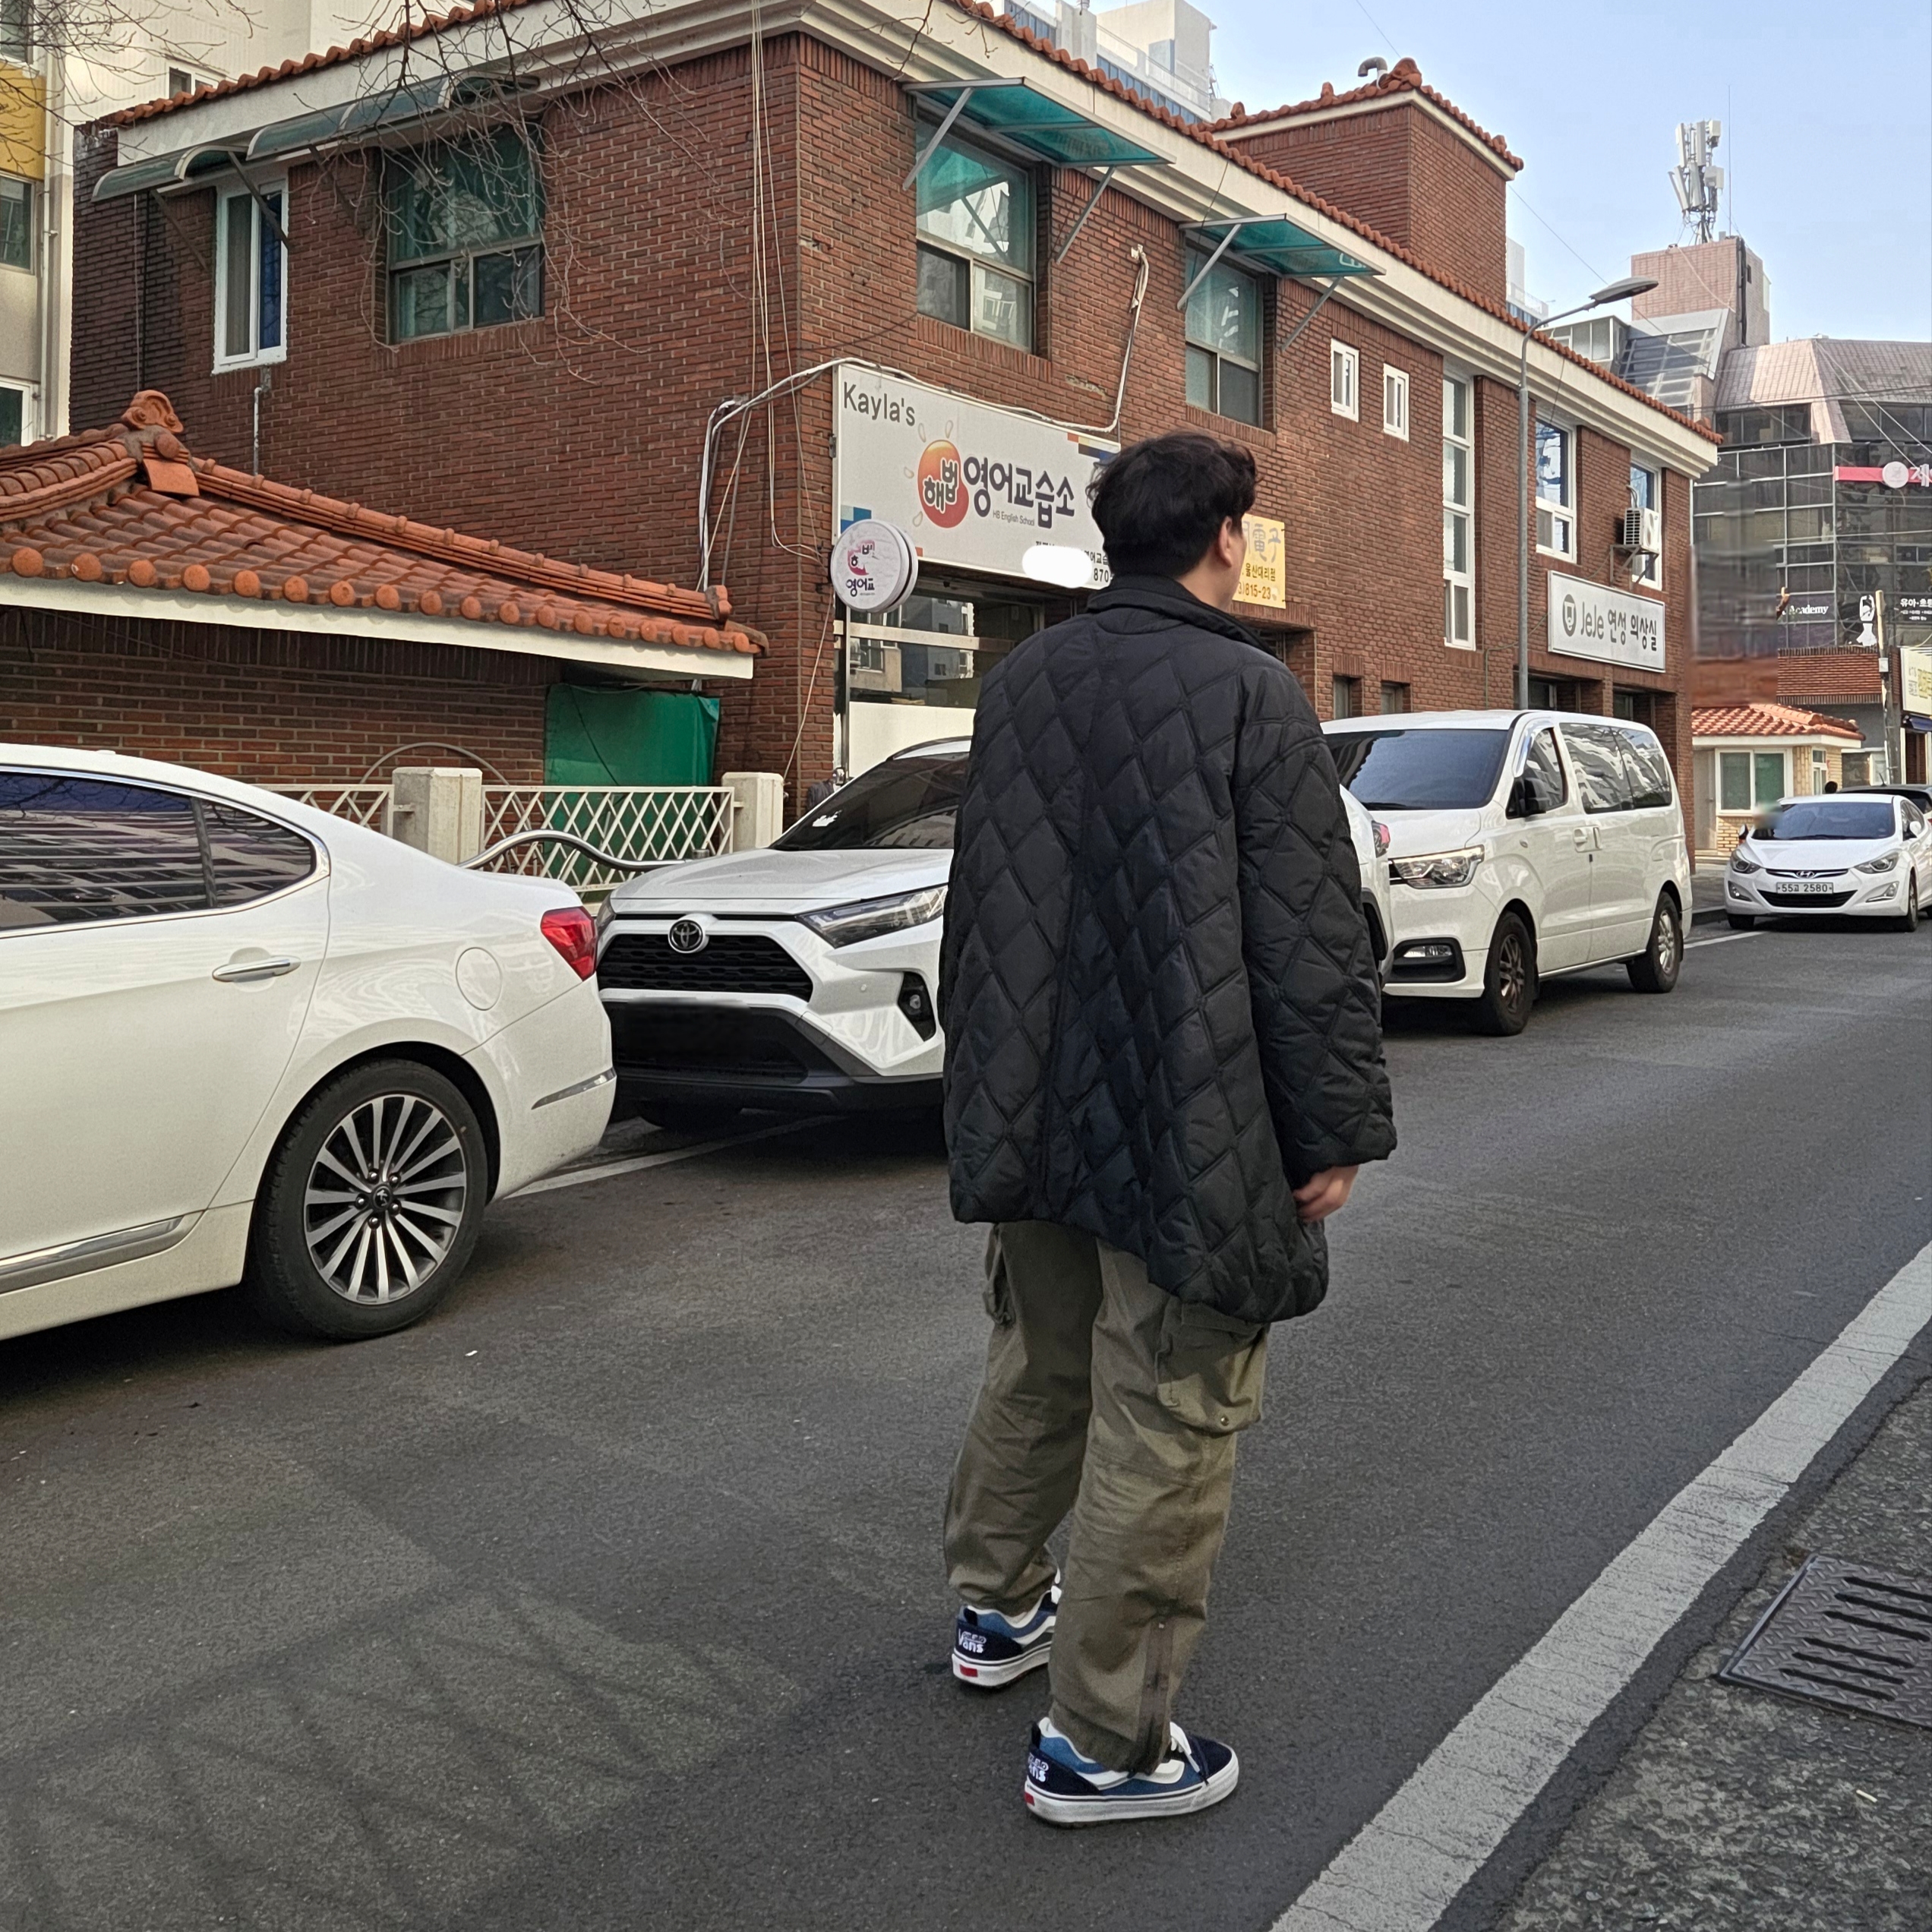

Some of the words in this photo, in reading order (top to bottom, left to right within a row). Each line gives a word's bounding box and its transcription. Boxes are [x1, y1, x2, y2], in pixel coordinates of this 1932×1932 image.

[844, 381, 916, 427] Kayla's
[924, 459, 958, 512] 해법
[963, 456, 1075, 529] 영어교습소
[1001, 511, 1019, 523] English
[1019, 515, 1035, 526] School
[1245, 563, 1276, 582] 울산대리점
[1789, 605, 1829, 615] Academy
[1608, 609, 1626, 646] 연성
[1630, 614, 1657, 652] 의상실
[1804, 884, 1828, 892] 2580
